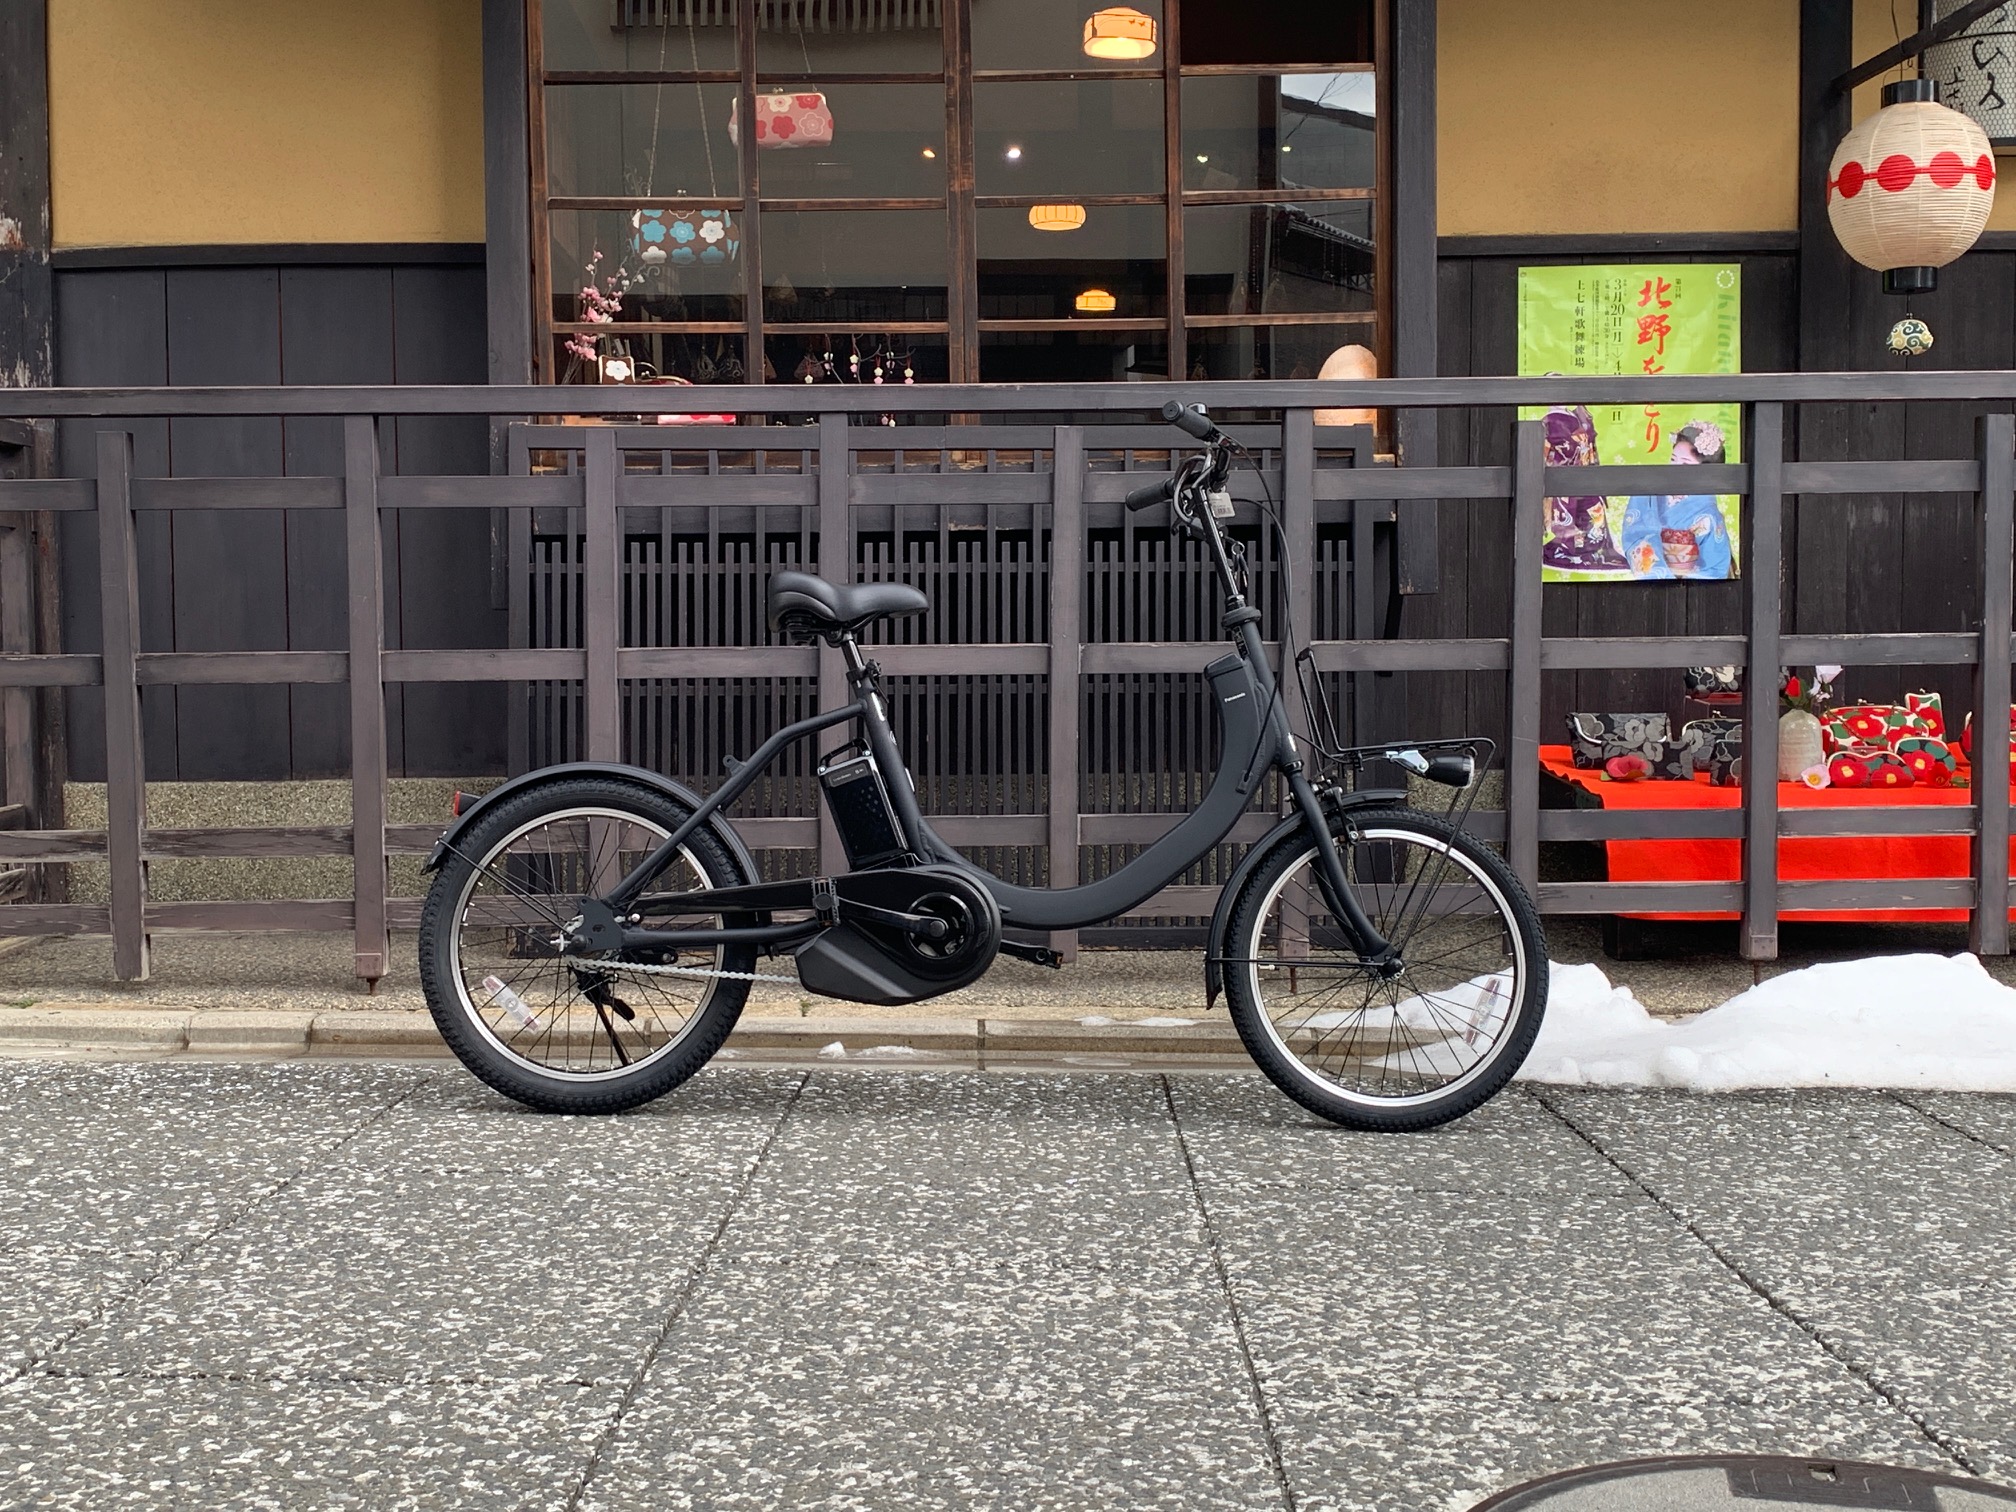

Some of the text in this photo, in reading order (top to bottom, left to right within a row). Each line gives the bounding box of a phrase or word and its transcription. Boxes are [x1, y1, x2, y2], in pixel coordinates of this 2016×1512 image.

[1944, 66, 1966, 113] 上七
[1575, 279, 1586, 369] 上七軒歌舞練場
